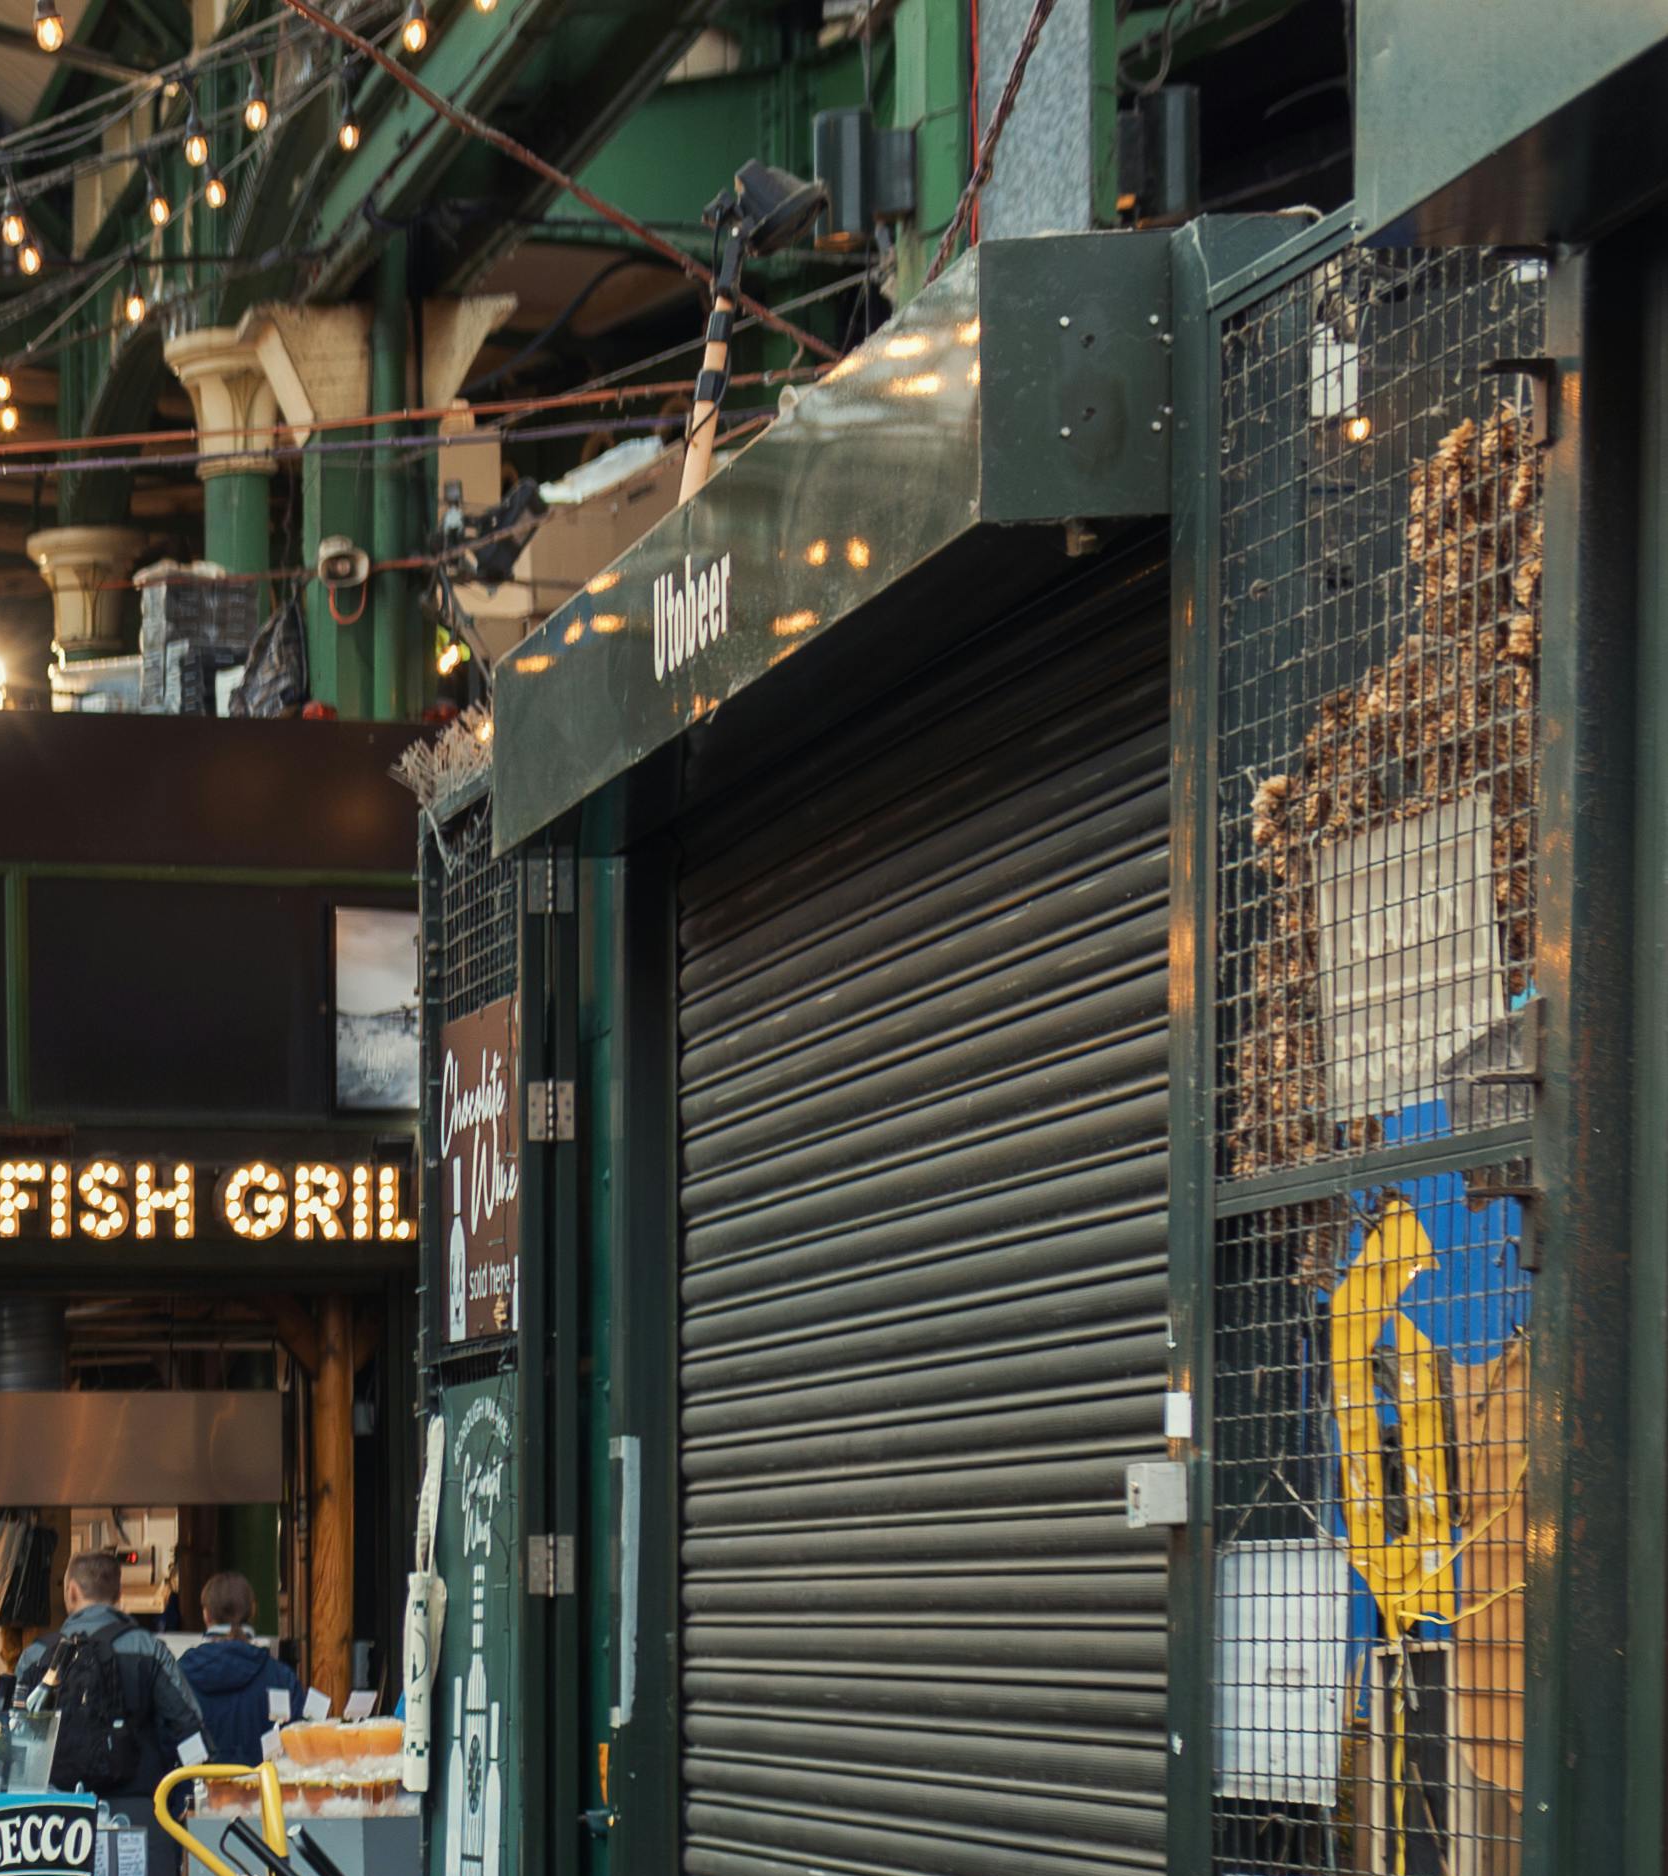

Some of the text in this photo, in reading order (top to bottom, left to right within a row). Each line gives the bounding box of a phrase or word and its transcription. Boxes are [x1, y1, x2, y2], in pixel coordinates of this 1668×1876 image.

[653, 551, 731, 683] Utobeer
[440, 1047, 506, 1160] Chocolate
[224, 1160, 418, 1242] GRIL
[469, 1260, 488, 1301] sold
